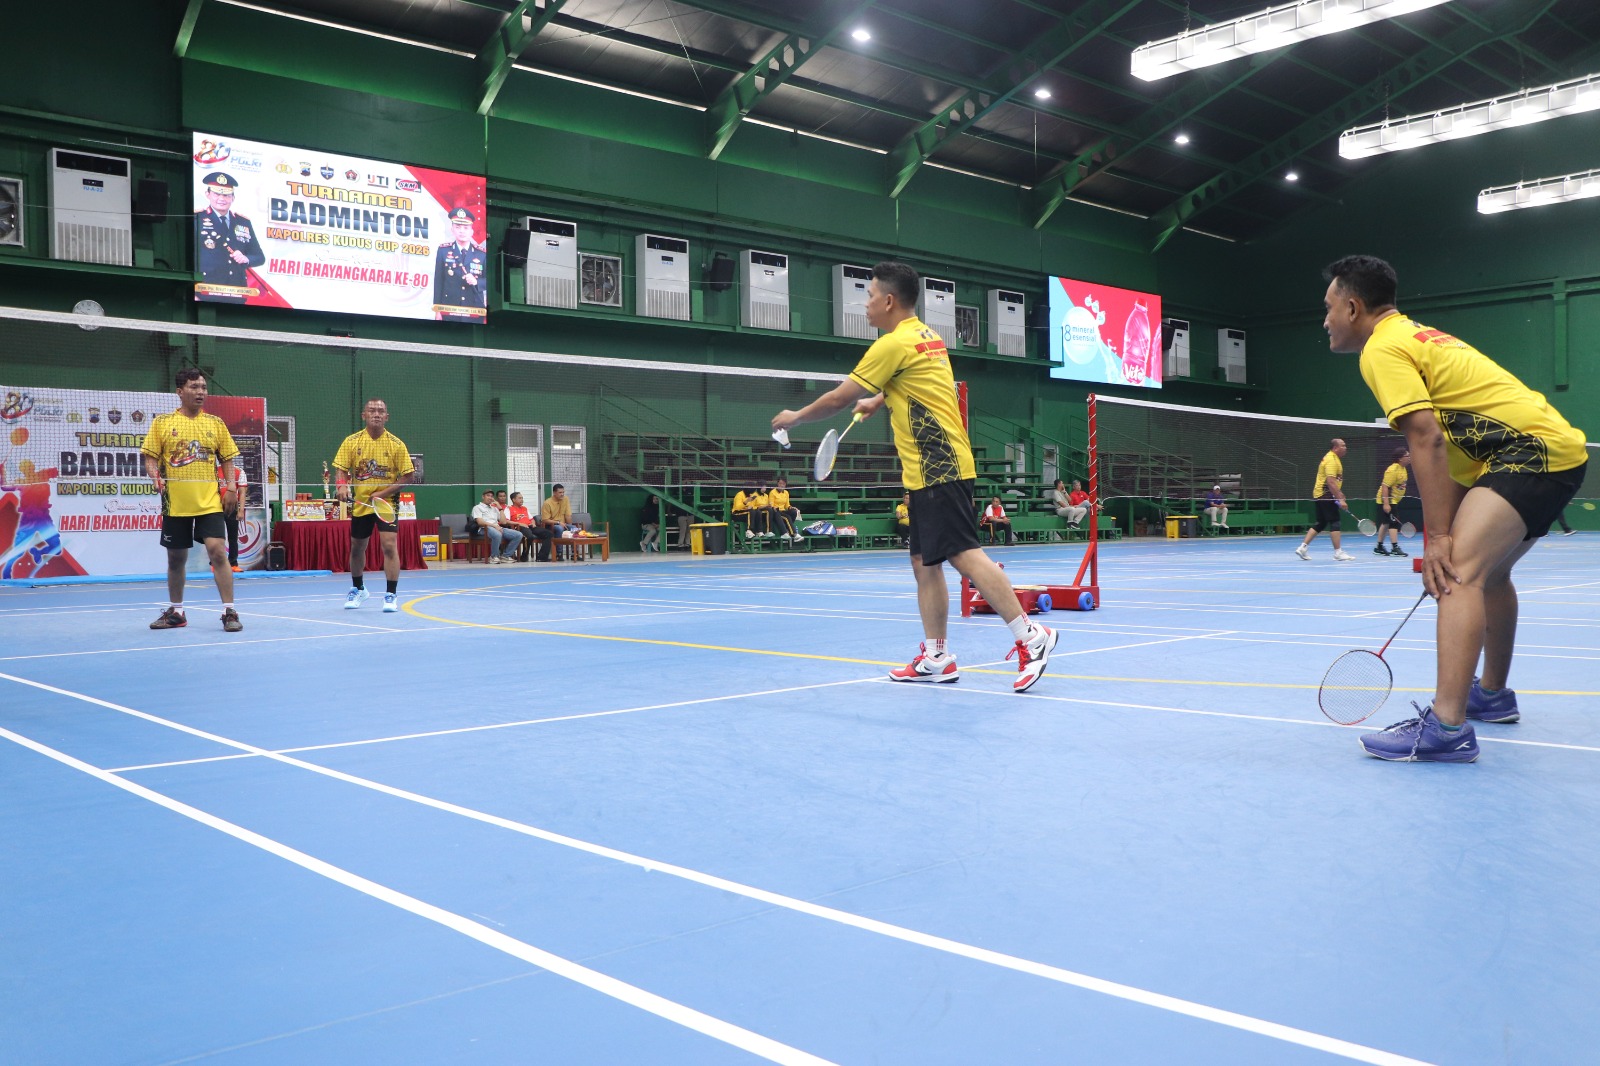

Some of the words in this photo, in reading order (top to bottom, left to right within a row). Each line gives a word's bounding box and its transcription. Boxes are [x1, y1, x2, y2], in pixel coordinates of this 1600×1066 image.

[286, 180, 412, 211] TURNAMEN
[270, 197, 429, 239] BADMINTON
[266, 226, 330, 245] KAPOLRES
[333, 234, 372, 249] KUDUS
[375, 239, 399, 253] CUP
[402, 243, 431, 256] 2026
[269, 258, 301, 275] HARI
[303, 261, 392, 284] BHAYANGKARA
[394, 271, 429, 288] KE-80
[1072, 325, 1095, 334] mineral
[1072, 334, 1097, 342] esensial
[75, 432, 147, 448] TURNA
[60, 451, 148, 477] BADMI
[57, 482, 118, 496] KAPOLRES
[121, 483, 158, 496] KUDUS
[60, 515, 91, 531] HARI
[92, 514, 163, 531] BHAYANGKA
